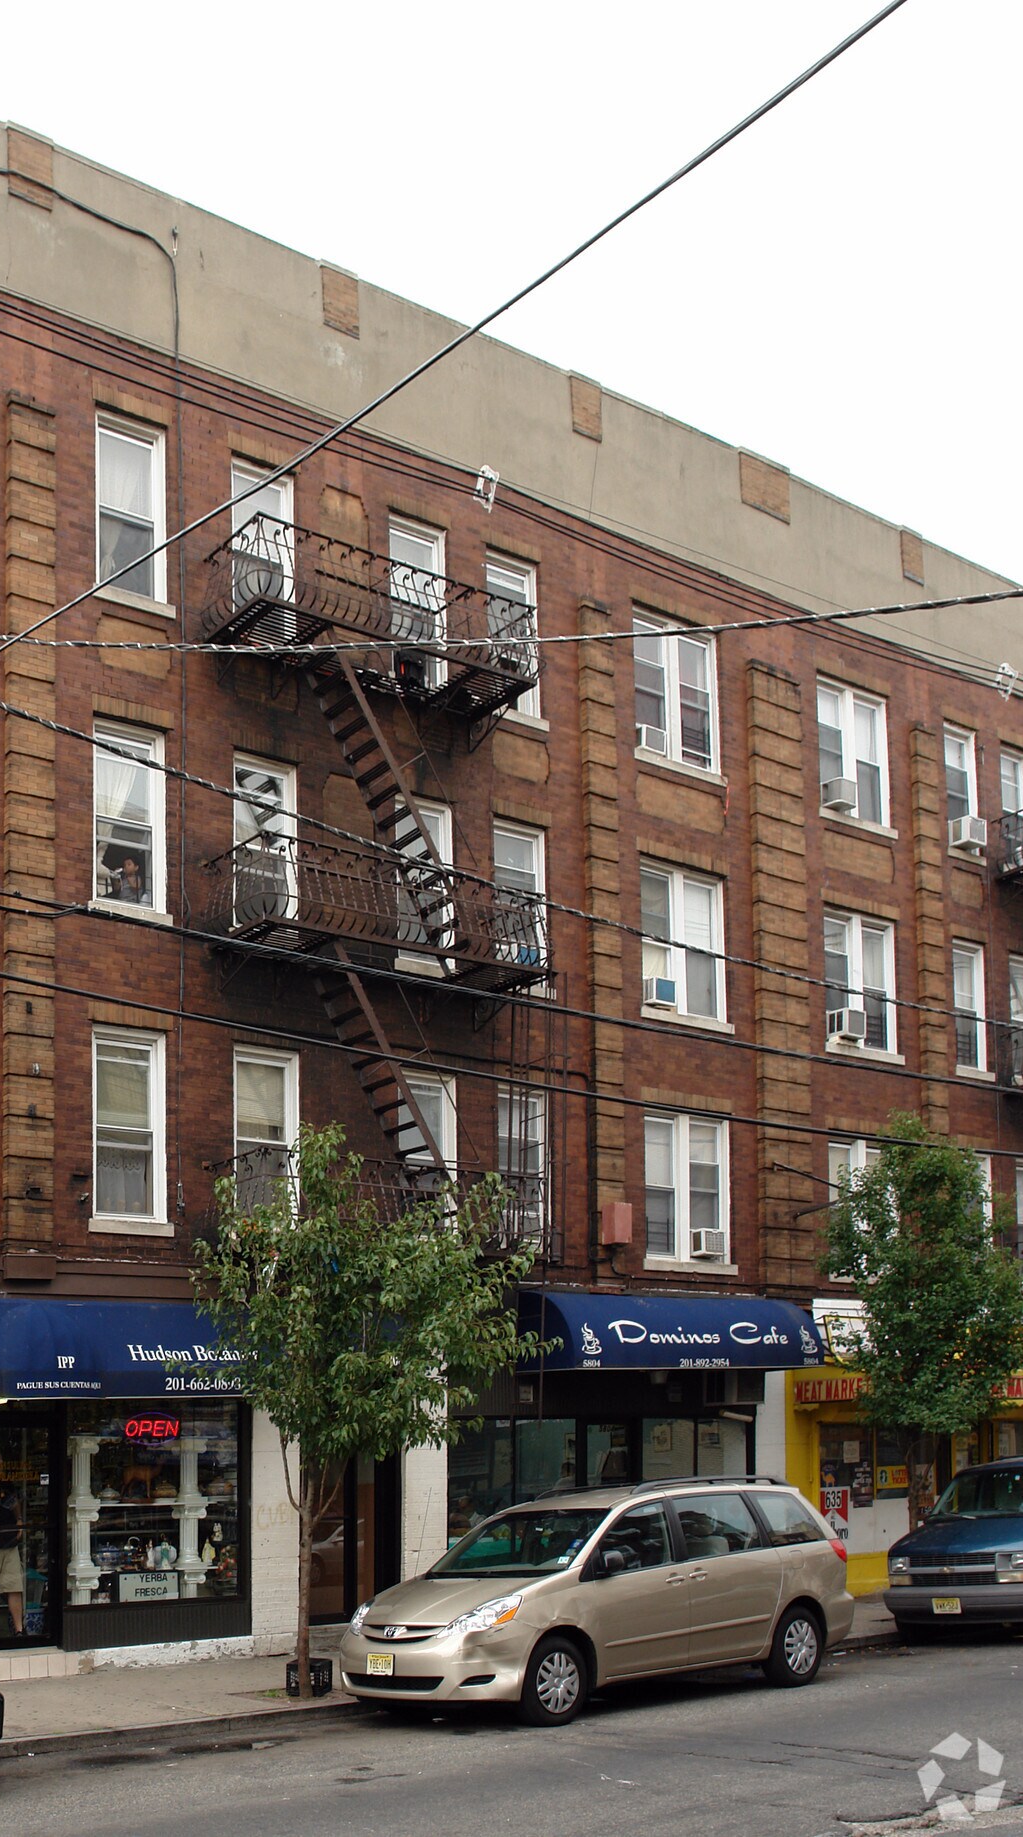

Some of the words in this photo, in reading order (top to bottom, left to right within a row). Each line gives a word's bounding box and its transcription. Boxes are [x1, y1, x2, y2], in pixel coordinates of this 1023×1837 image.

[607, 1319, 721, 1345] Dominos
[729, 1321, 789, 1345] Cafe
[127, 1344, 193, 1362] Hudson
[57, 1355, 75, 1369] IPP
[582, 1359, 601, 1368] 5804
[679, 1358, 730, 1368] 201-892-2954
[16, 1381, 44, 1390] PAGUE
[44, 1381, 59, 1389] SUS
[60, 1381, 90, 1389] CUENTAS
[796, 1381, 823, 1402] MEAT
[126, 1420, 179, 1437] OPEN
[825, 1490, 842, 1508] 635
[139, 1572, 168, 1583] YERBA
[134, 1587, 168, 1597] FRESCA
